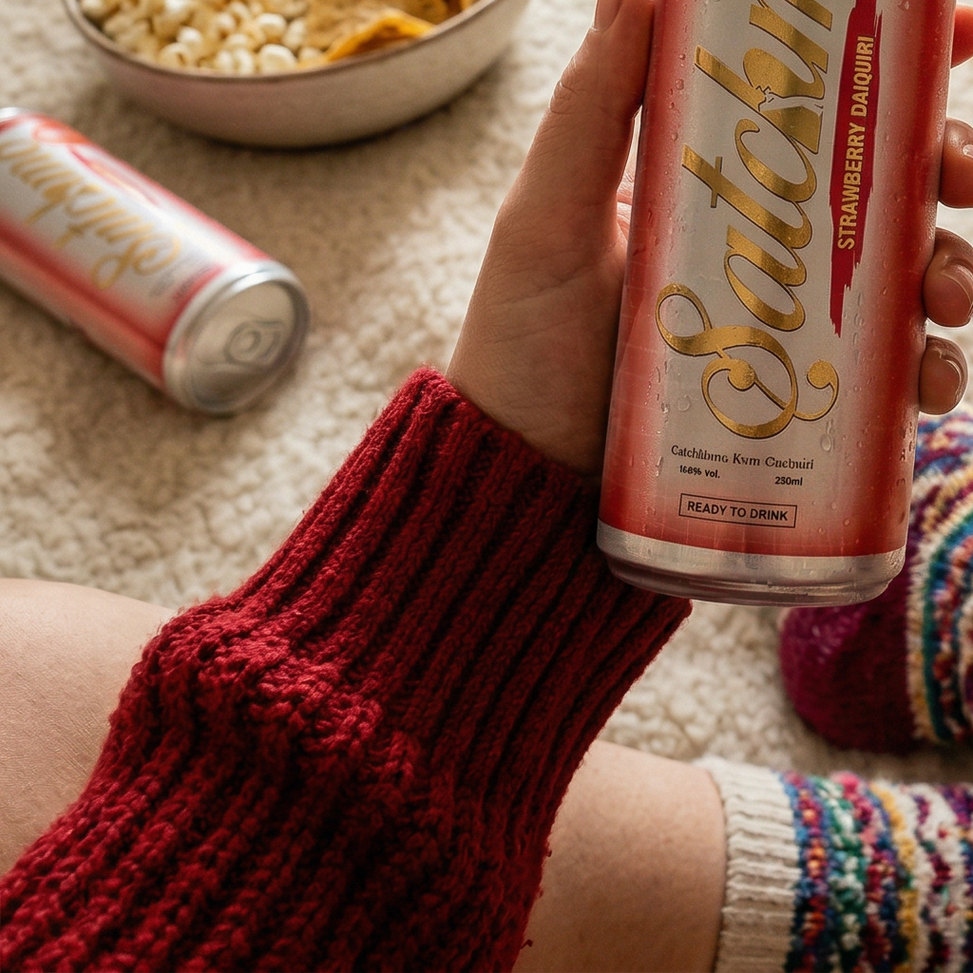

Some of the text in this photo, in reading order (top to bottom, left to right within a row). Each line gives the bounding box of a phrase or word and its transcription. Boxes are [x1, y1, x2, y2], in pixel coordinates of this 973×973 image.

[837, 35, 875, 250] STRAWBERRY DAIQUIRI
[687, 500, 789, 521] READY TO DRINK
